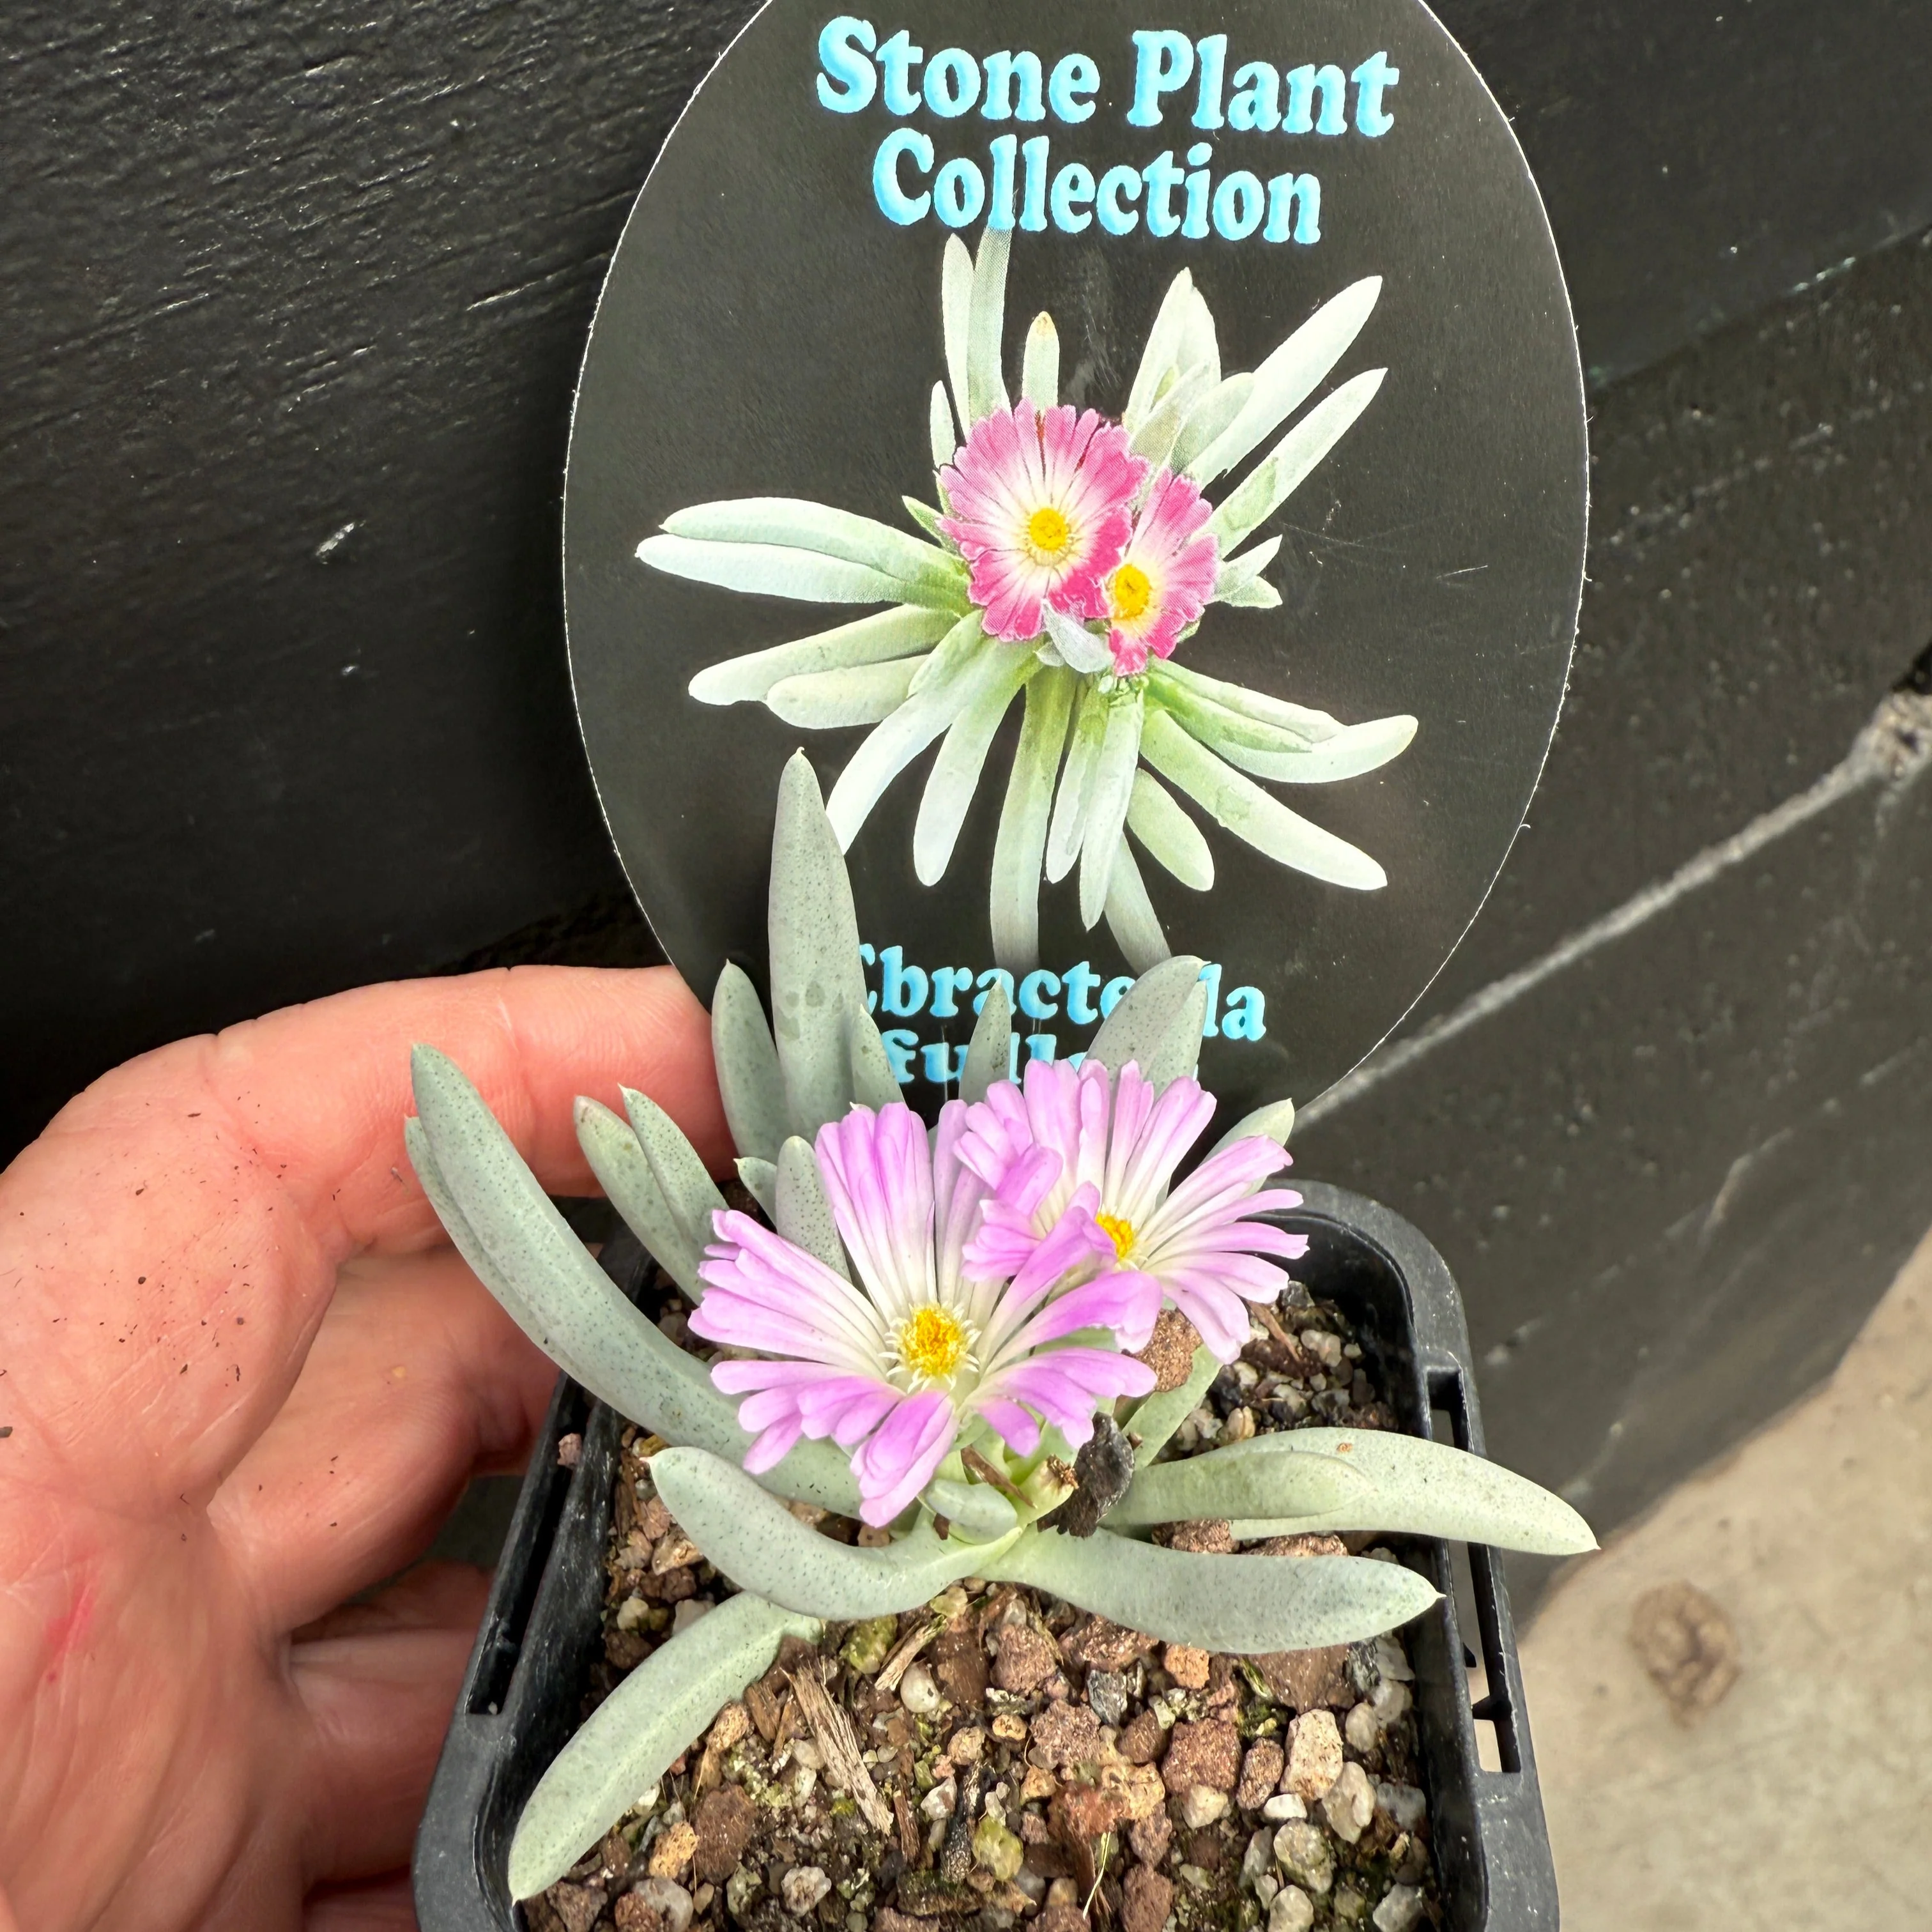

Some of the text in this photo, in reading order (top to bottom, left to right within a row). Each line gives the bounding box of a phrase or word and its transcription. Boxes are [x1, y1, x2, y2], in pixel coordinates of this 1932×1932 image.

[816, 15, 1400, 138] Stone Plant
[872, 128, 1322, 245] Collection
